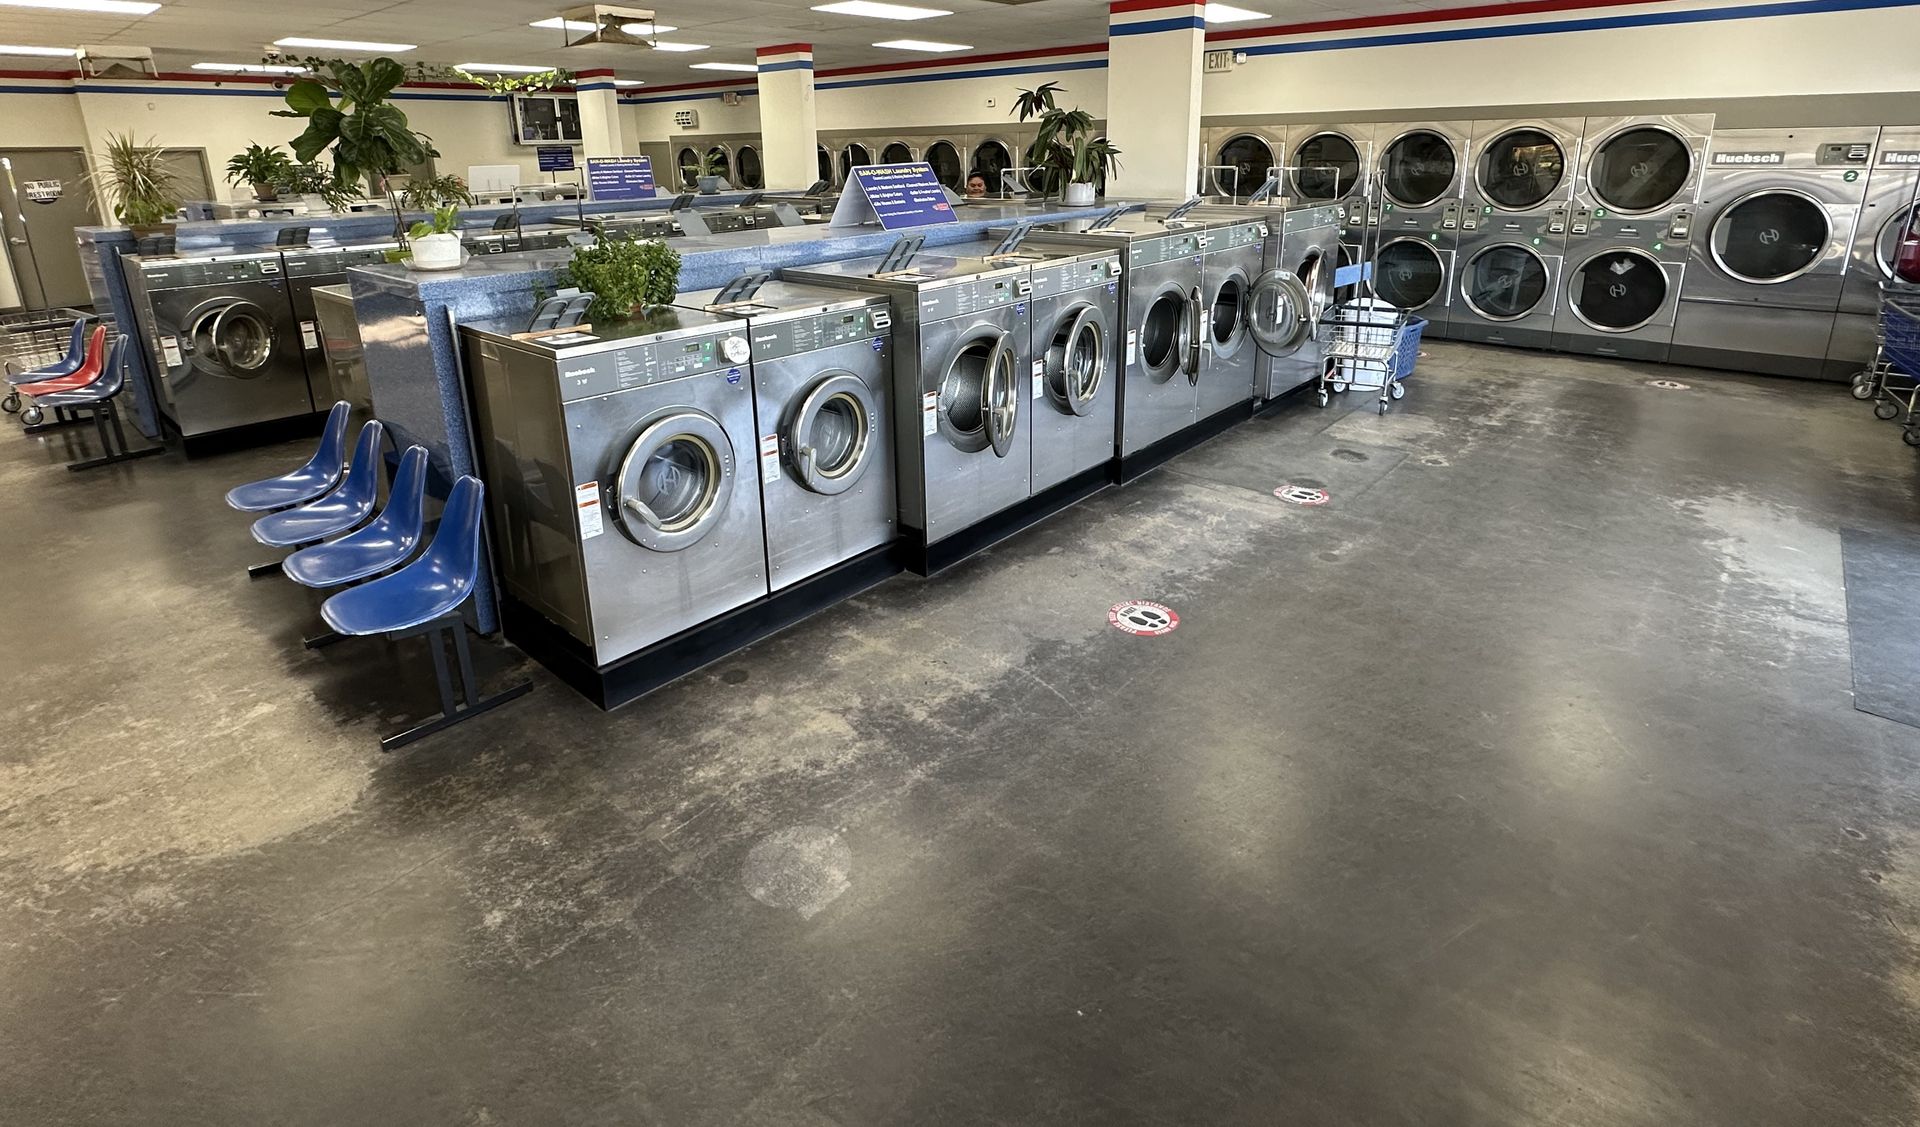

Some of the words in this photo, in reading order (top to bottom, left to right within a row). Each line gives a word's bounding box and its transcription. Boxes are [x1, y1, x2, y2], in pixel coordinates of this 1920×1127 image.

[1208, 52, 1228, 69] EXIT
[1716, 153, 1780, 163] Huebsch
[1885, 153, 1920, 163] Hue
